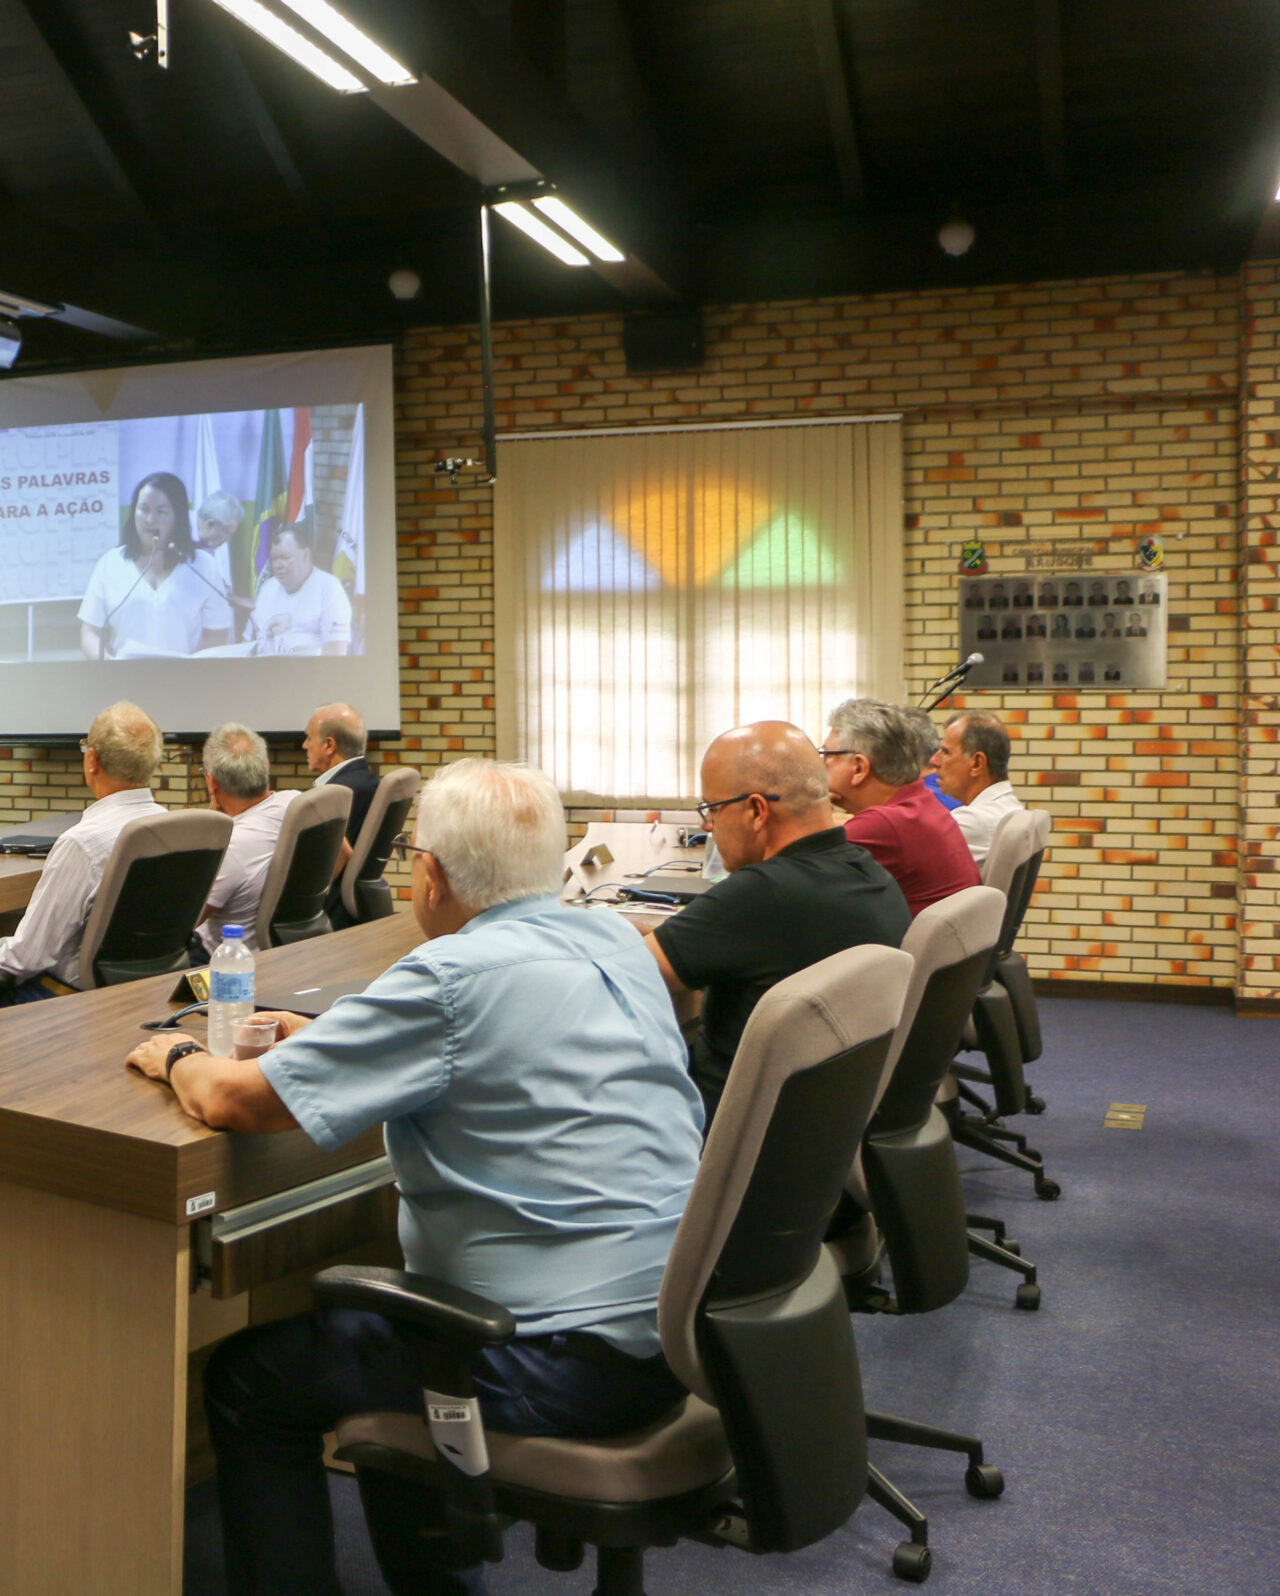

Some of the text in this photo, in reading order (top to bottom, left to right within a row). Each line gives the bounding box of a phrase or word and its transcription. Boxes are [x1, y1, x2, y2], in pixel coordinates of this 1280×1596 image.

[18, 471, 110, 488] PALAVRAS
[36, 503, 48, 517] A
[54, 498, 103, 518] AÇÃO
